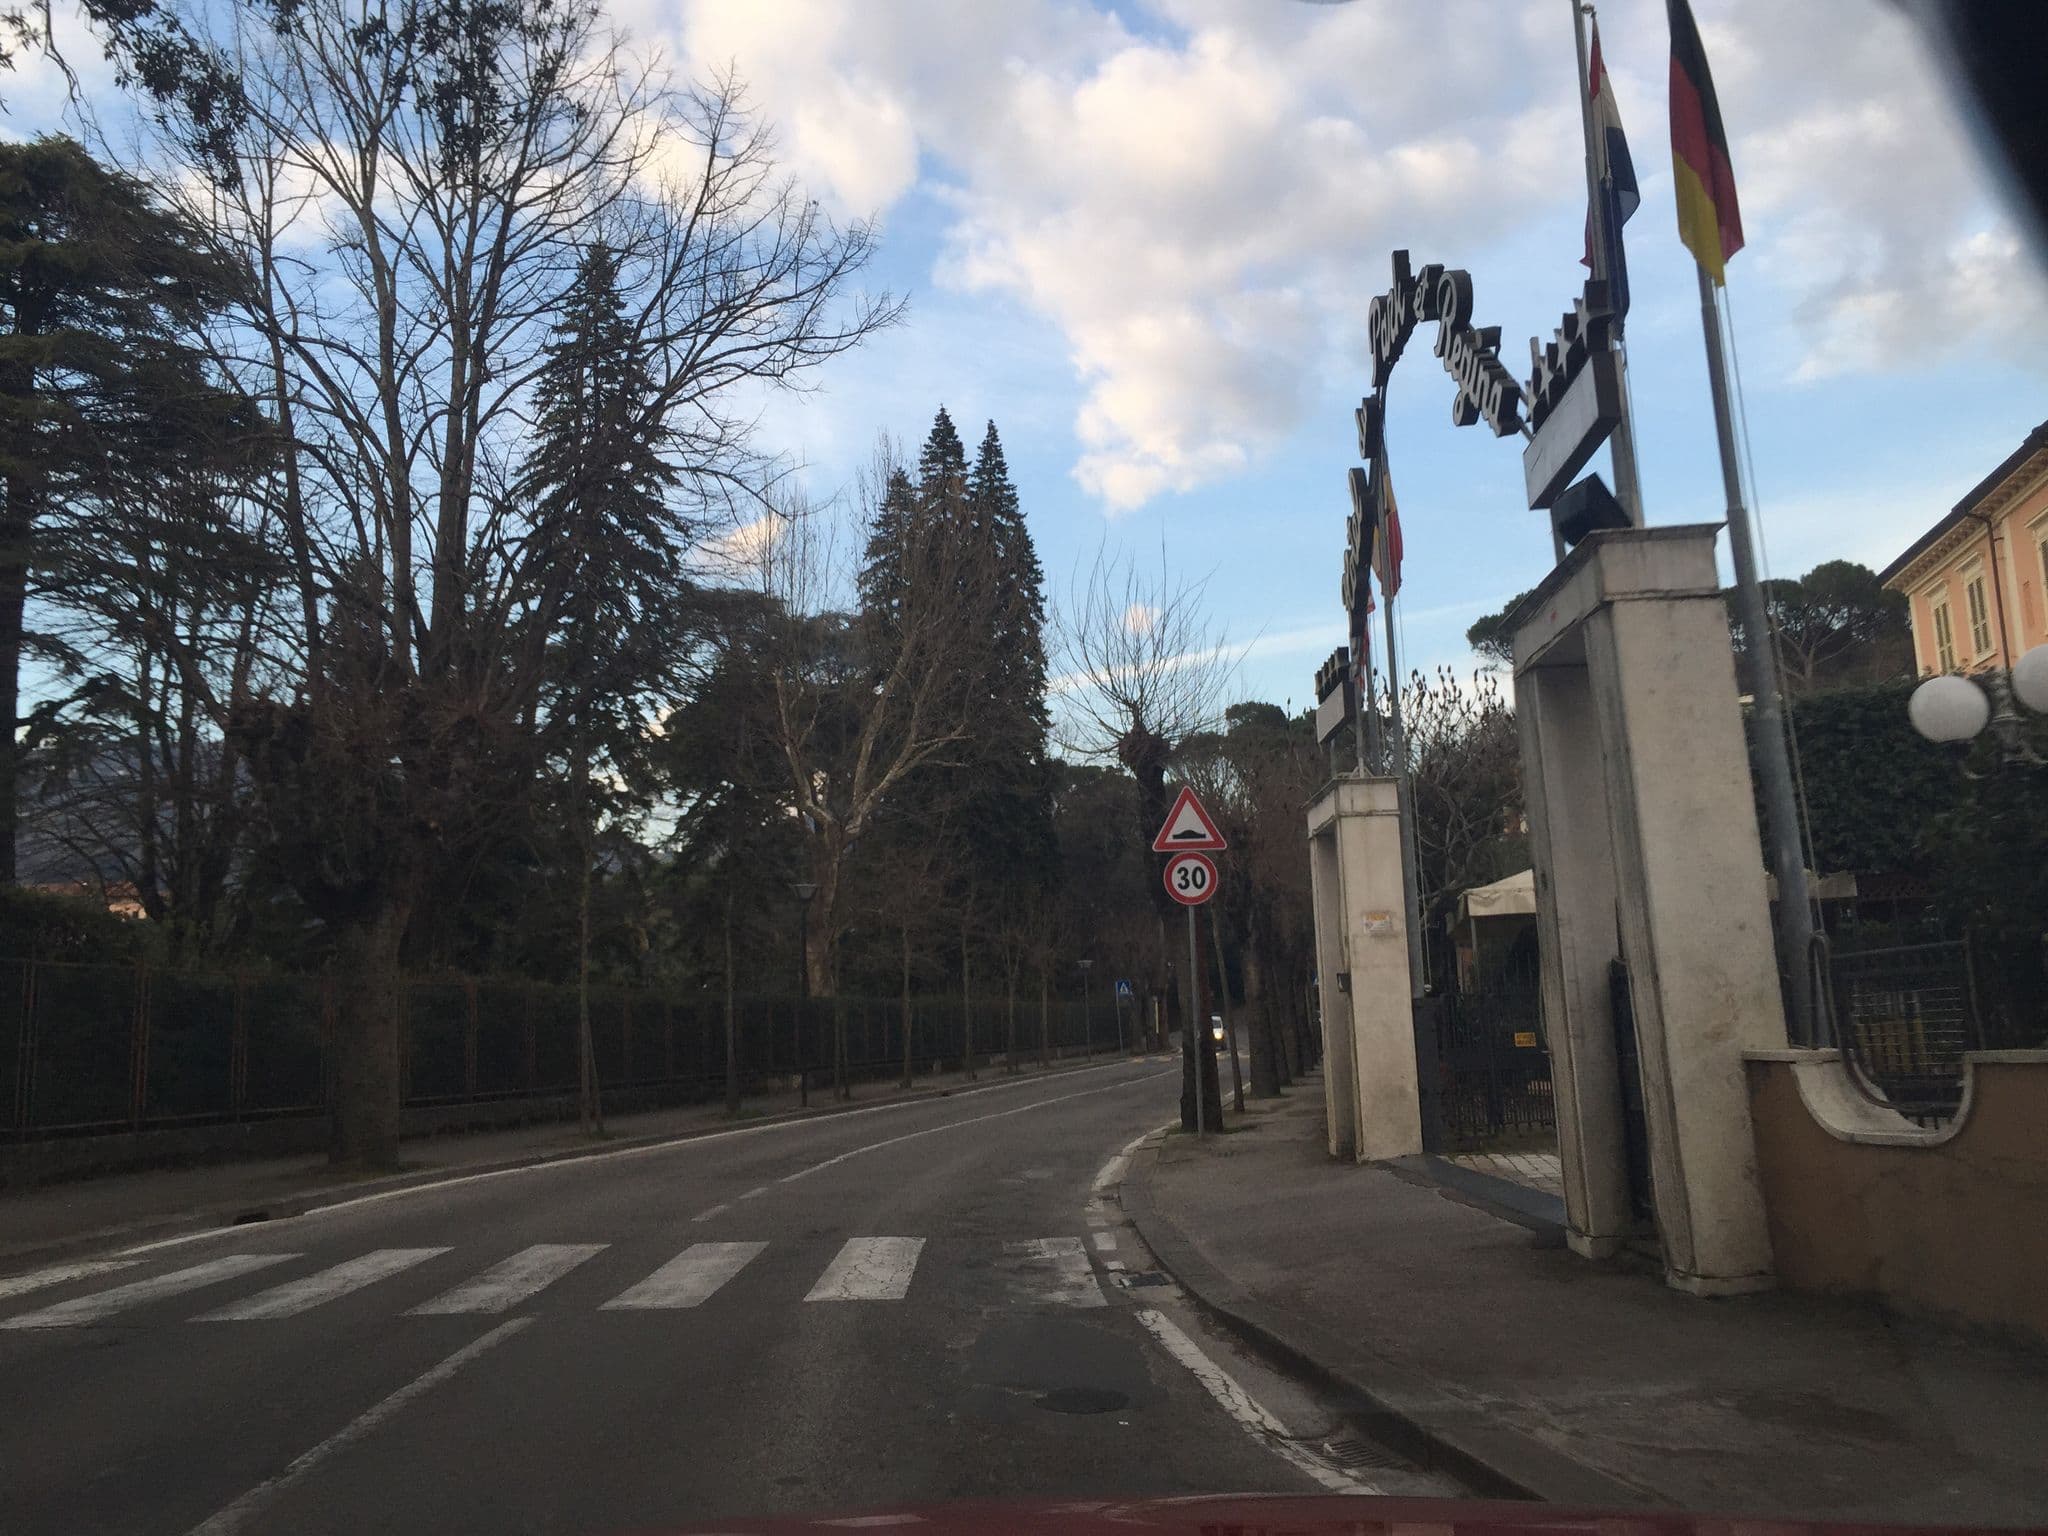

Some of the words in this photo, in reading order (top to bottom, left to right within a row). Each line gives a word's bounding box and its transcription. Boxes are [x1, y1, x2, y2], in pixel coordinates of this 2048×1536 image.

[1368, 250, 1408, 387] Park
[1413, 264, 1436, 321] et
[1434, 270, 1517, 437] Regina
[1176, 865, 1206, 890] 30
